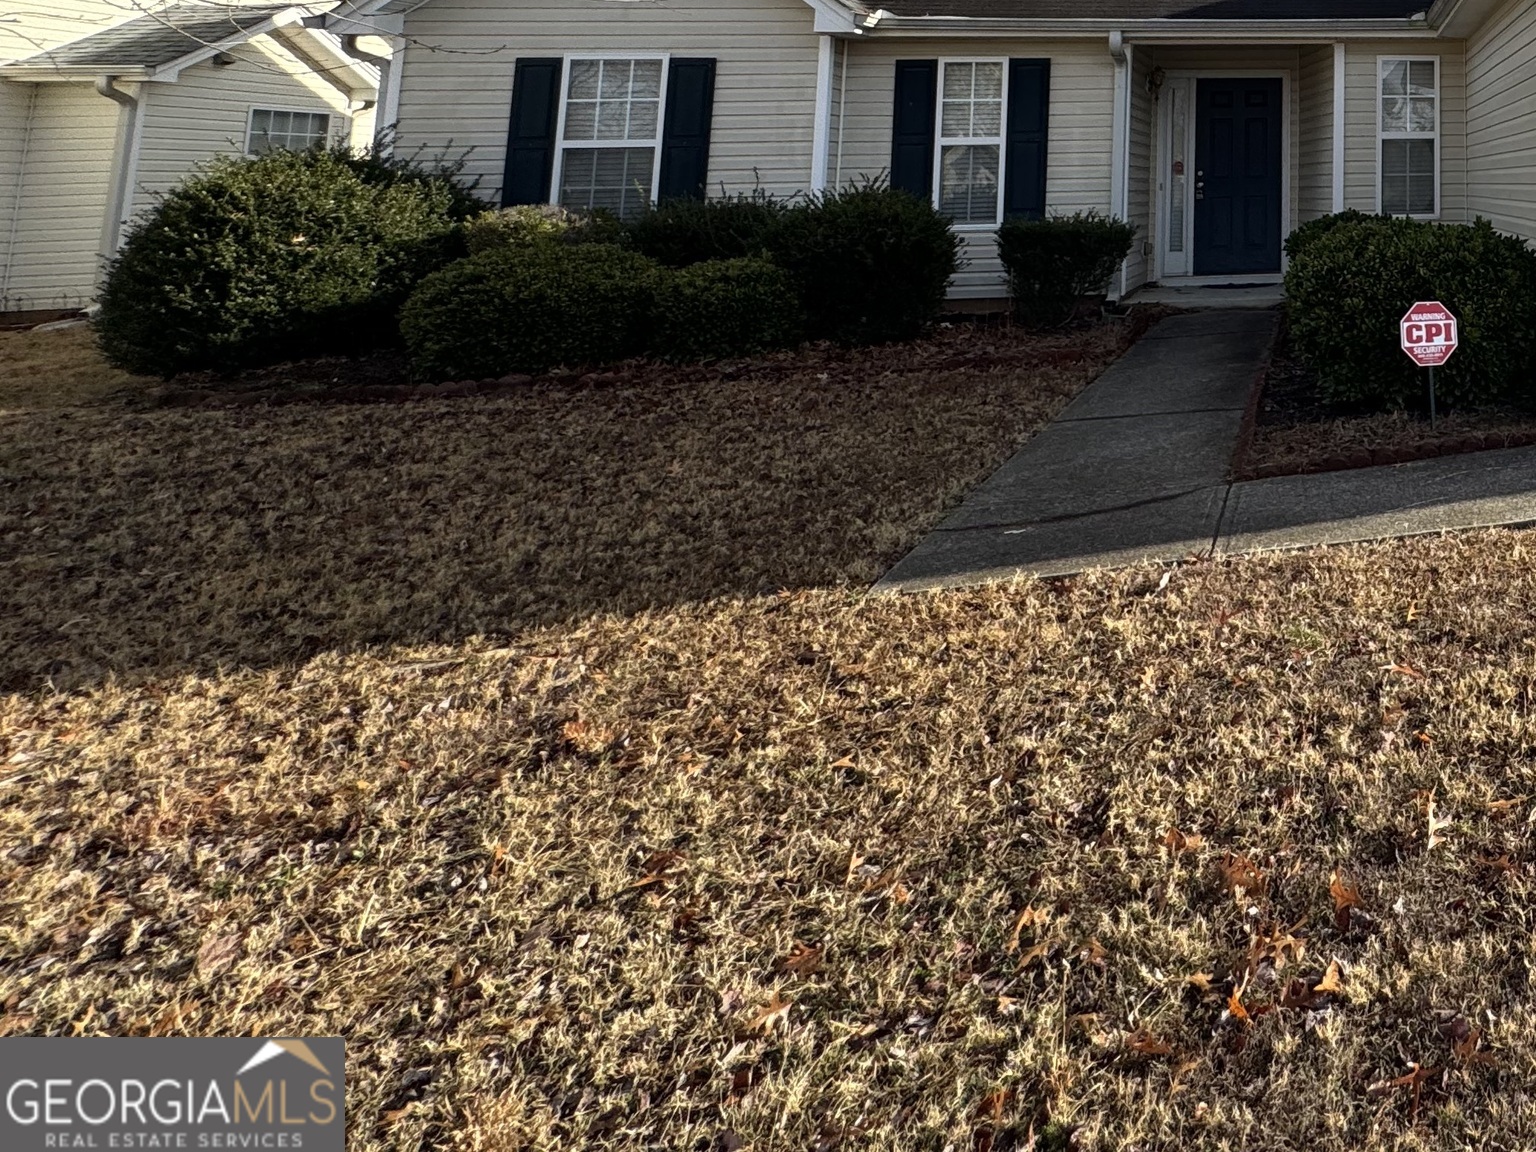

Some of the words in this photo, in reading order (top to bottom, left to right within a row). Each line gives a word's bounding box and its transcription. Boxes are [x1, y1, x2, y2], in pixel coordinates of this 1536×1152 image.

[1411, 312, 1445, 321] WARNING
[1405, 323, 1453, 344] CPI
[1413, 345, 1446, 355] SECURITY
